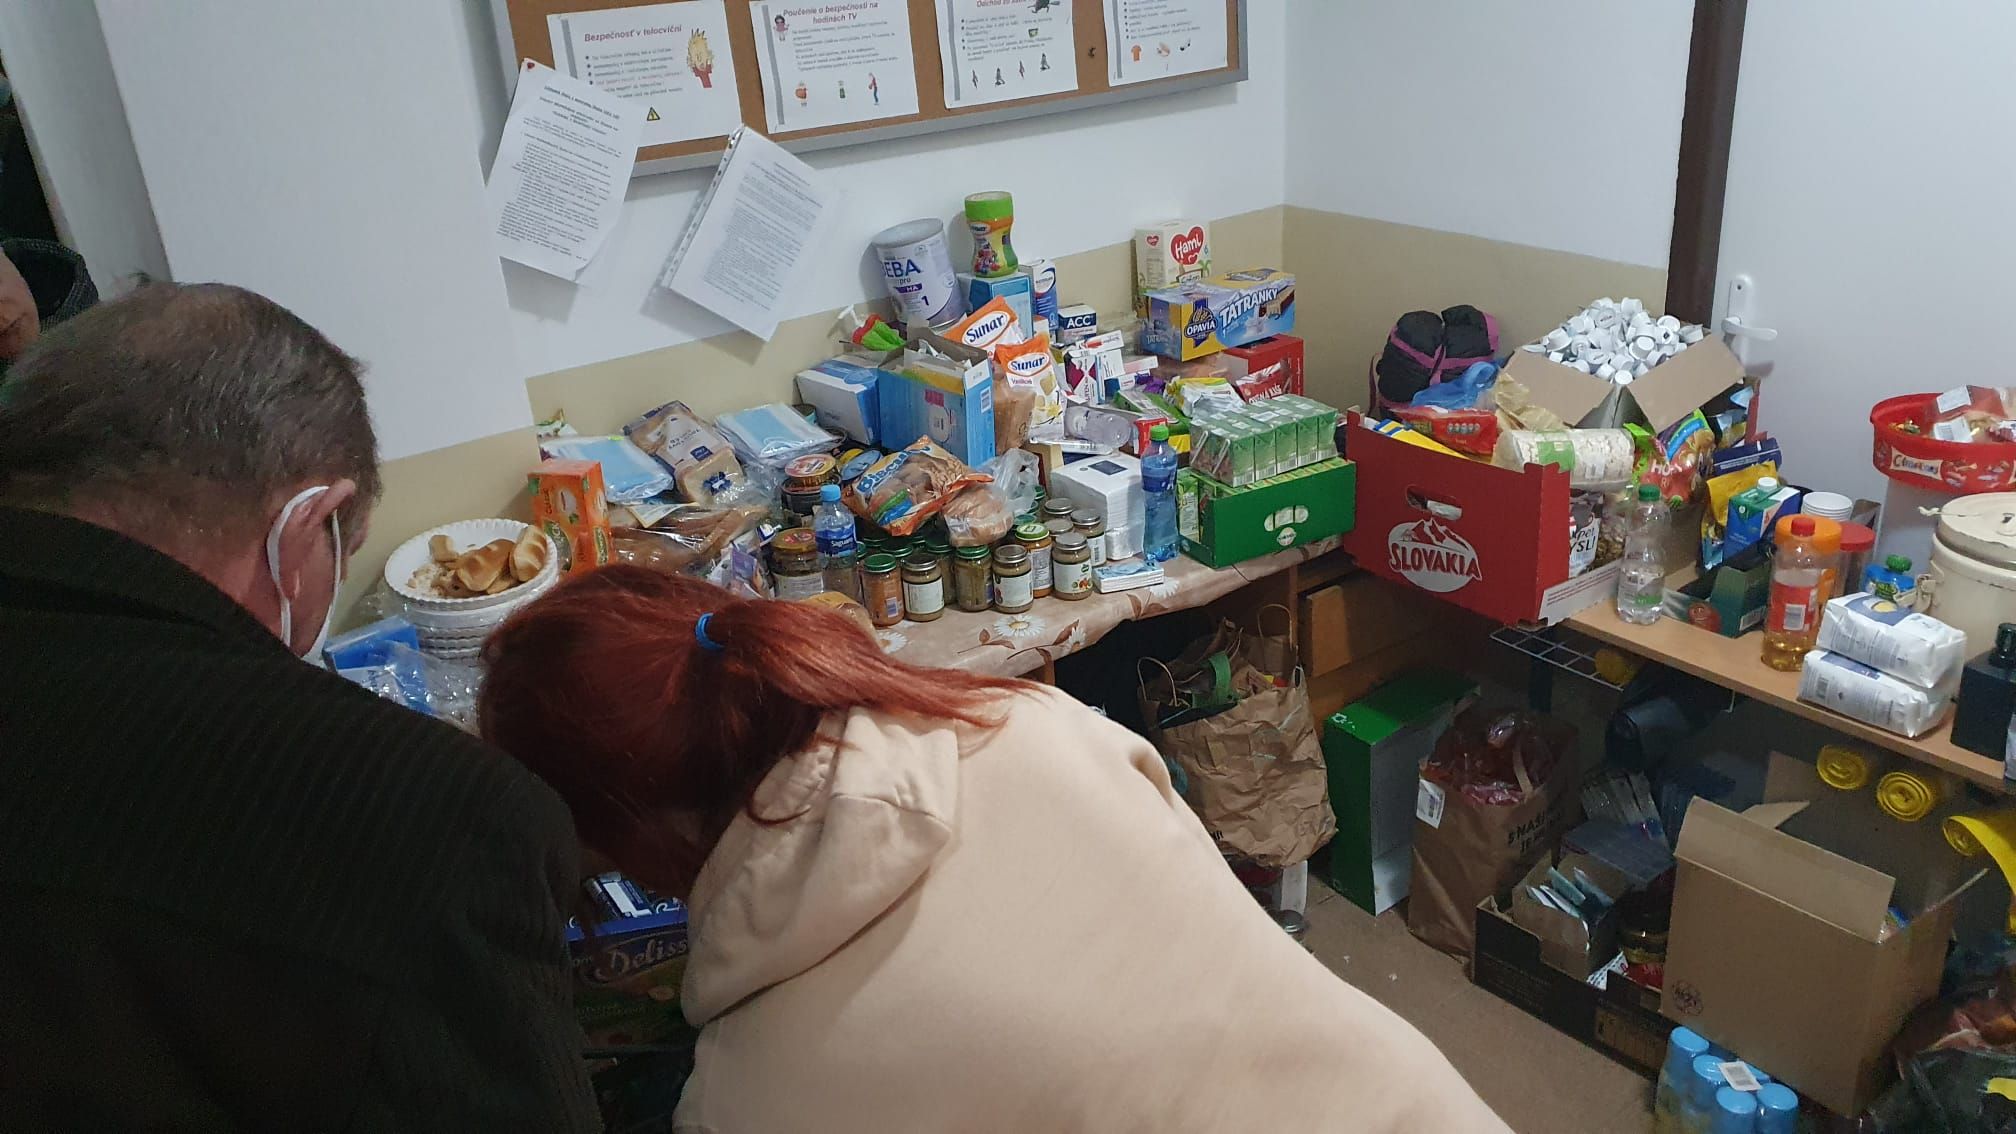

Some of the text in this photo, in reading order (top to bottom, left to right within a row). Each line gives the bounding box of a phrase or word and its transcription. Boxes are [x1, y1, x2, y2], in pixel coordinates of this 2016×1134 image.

[783, 7, 818, 16] Poučenie
[825, 2, 868, 14] bezpečnosti
[812, 12, 858, 24] hodinách TV
[584, 29, 635, 42] Bezpečnosť
[1175, 234, 1202, 259] Hami
[906, 285, 919, 293] HA
[921, 295, 930, 306] 1
[1219, 288, 1279, 328] TATRANKY
[966, 314, 1004, 343] Sunar
[1066, 316, 1092, 328] ACC
[1186, 320, 1216, 336] OPAVIA
[1010, 356, 1045, 370] Sunar
[1569, 535, 1596, 555] YSLI
[1390, 542, 1480, 580] SLOVAKIA
